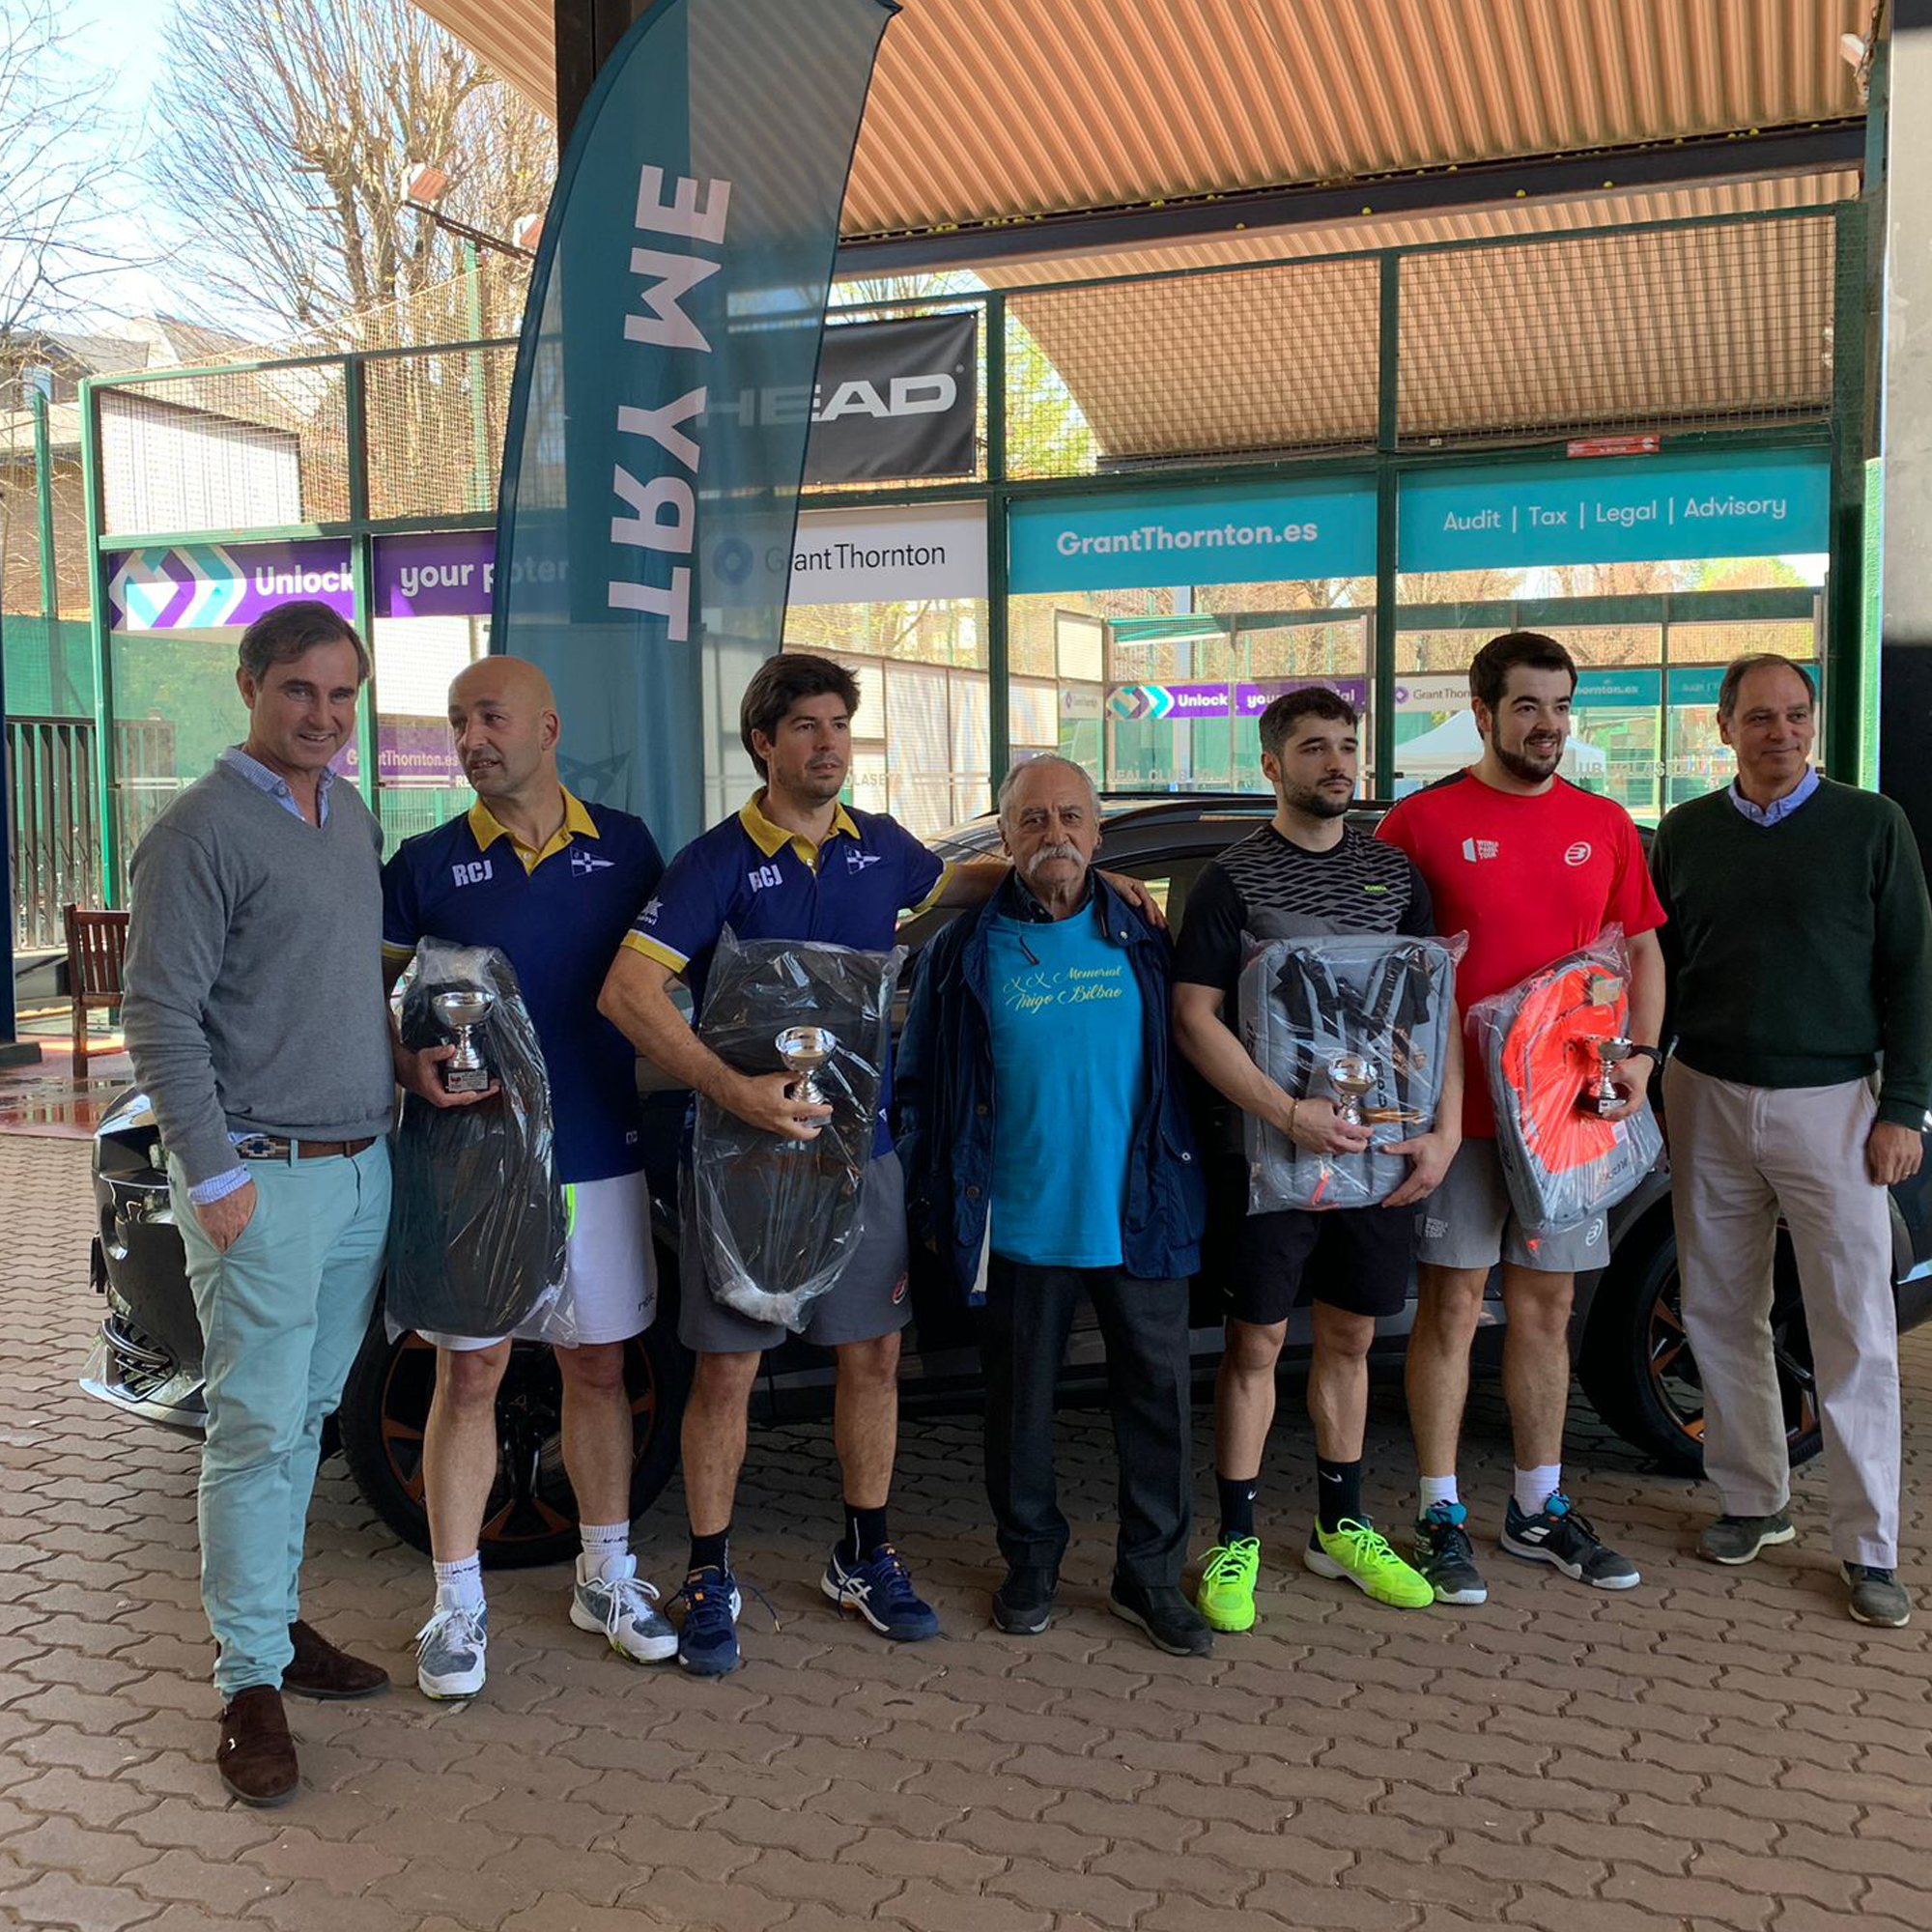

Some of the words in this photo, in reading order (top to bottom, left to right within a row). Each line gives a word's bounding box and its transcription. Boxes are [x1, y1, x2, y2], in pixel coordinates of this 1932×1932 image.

[696, 373, 956, 428] HEAD
[1443, 509, 1502, 531] Audit
[1528, 506, 1567, 526] Tax
[1596, 500, 1657, 527] Legal
[1684, 496, 1786, 519] Advisory
[1057, 523, 1319, 555] GrantThornton.es
[255, 562, 355, 597] Unlock
[400, 564, 473, 597] your
[1178, 692, 1228, 707] Unlock
[451, 859, 494, 887] RCJ
[748, 864, 783, 893] RCJ
